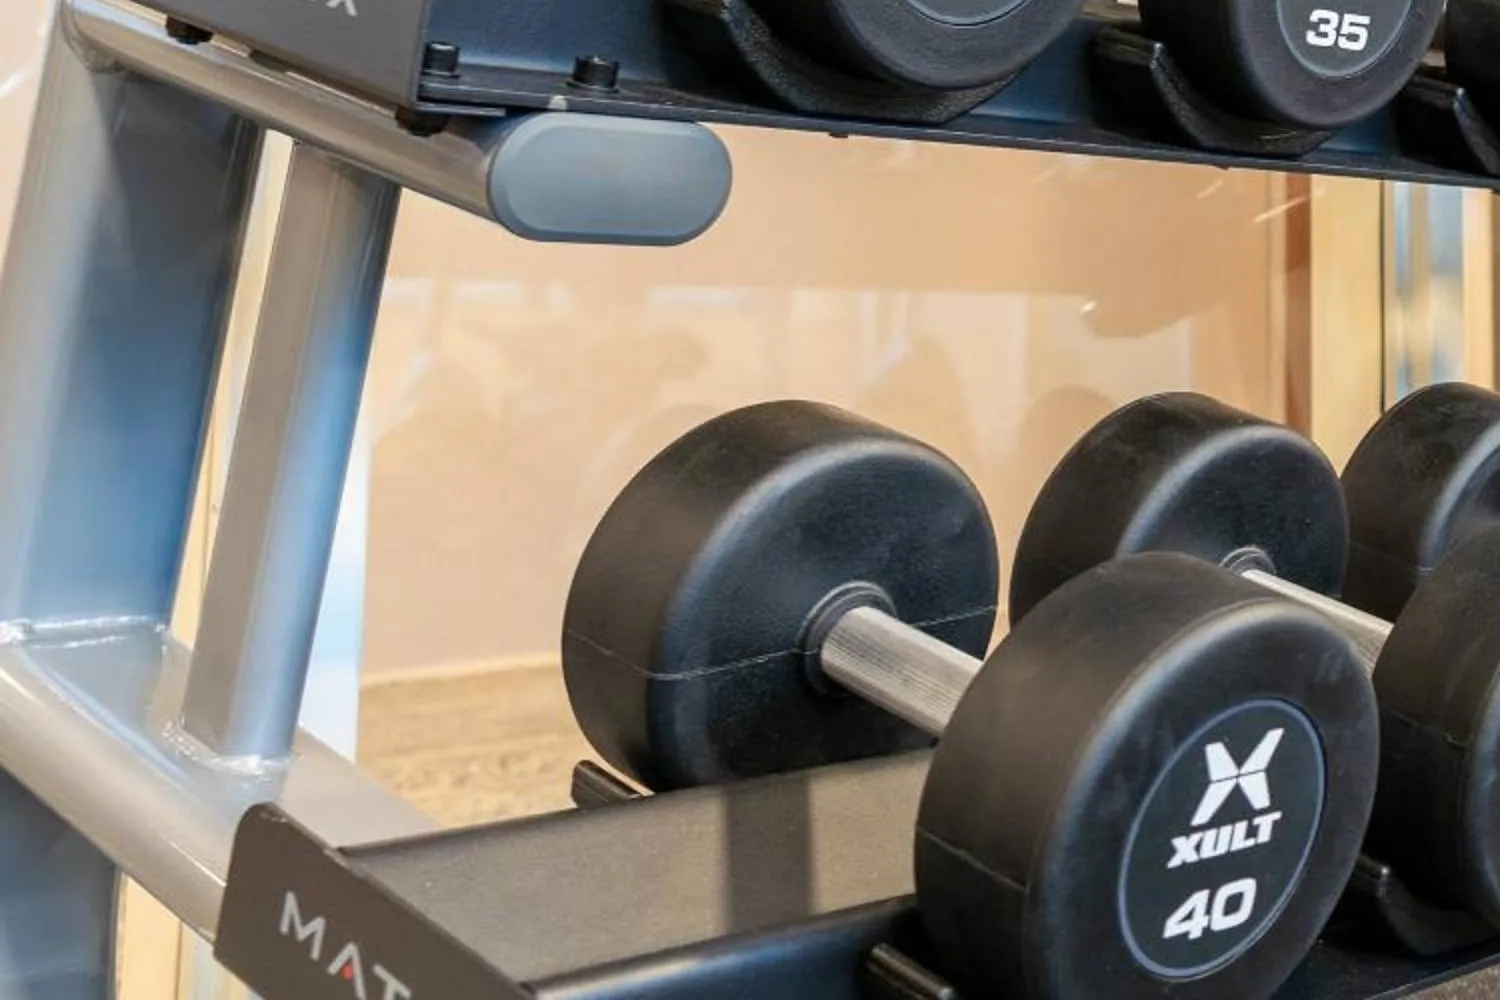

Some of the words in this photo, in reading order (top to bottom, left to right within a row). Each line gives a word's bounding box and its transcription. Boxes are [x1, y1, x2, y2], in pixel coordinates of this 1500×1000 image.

[1305, 8, 1371, 51] 35
[1167, 811, 1282, 868] XULT
[1163, 877, 1257, 940] 40
